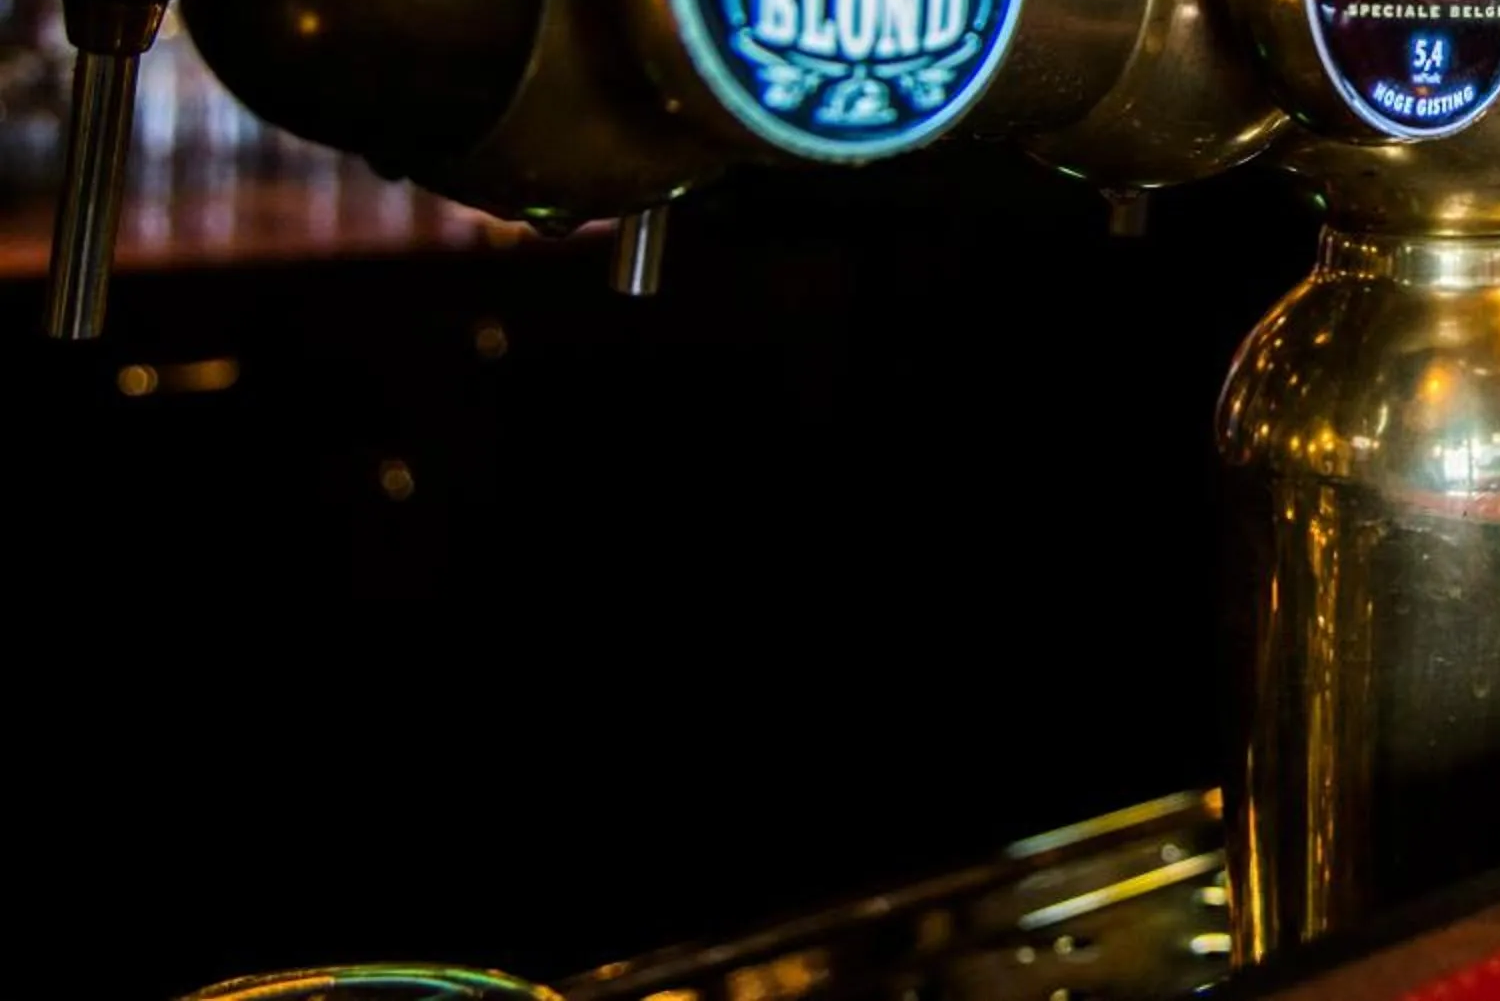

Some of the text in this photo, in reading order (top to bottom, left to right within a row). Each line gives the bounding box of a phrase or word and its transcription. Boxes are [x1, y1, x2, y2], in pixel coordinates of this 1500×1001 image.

[1348, 4, 1441, 19] SPECIALE
[1373, 81, 1474, 117] HOGE GISTING
